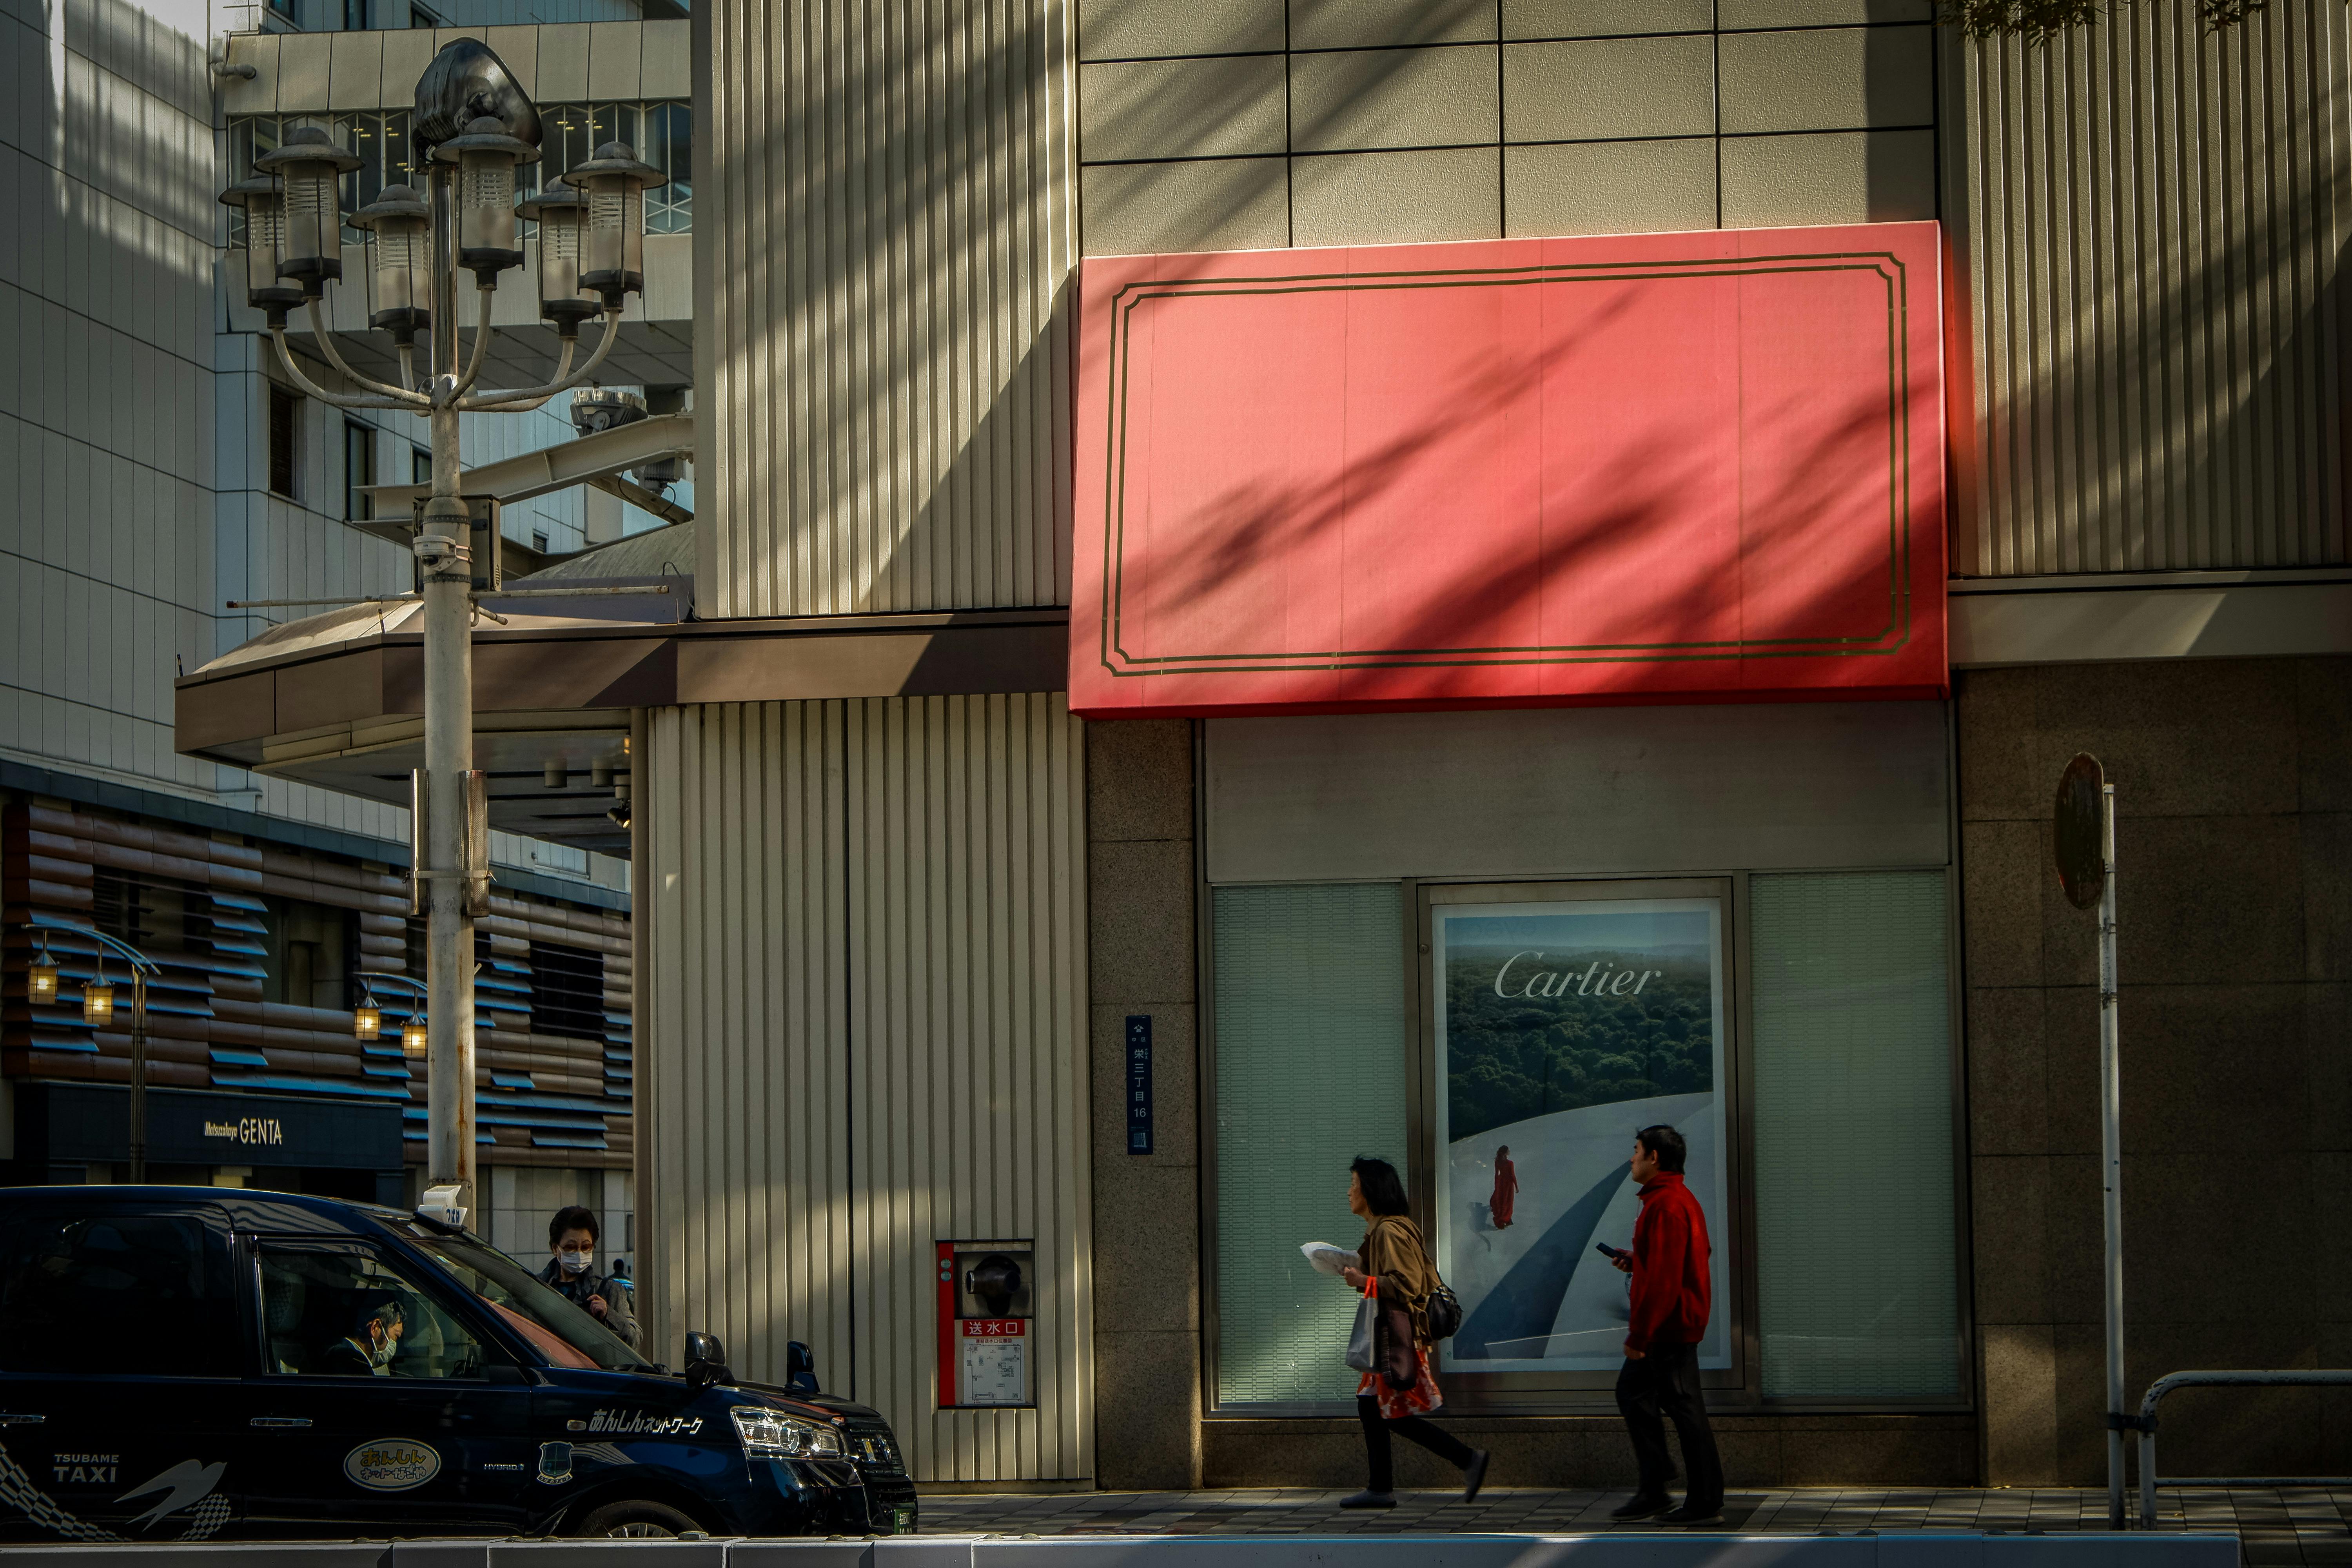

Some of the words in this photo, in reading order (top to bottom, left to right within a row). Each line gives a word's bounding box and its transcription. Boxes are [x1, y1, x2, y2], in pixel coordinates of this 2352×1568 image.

[1495, 950, 1662, 998] Cartier
[239, 1117, 282, 1145] GENTA
[969, 1321, 1018, 1335] 送水口
[588, 1408, 703, 1435] あんしんネットワーク
[54, 1454, 119, 1463] TSUBAME
[360, 1447, 426, 1466] あんしん
[53, 1466, 117, 1483] TAXI
